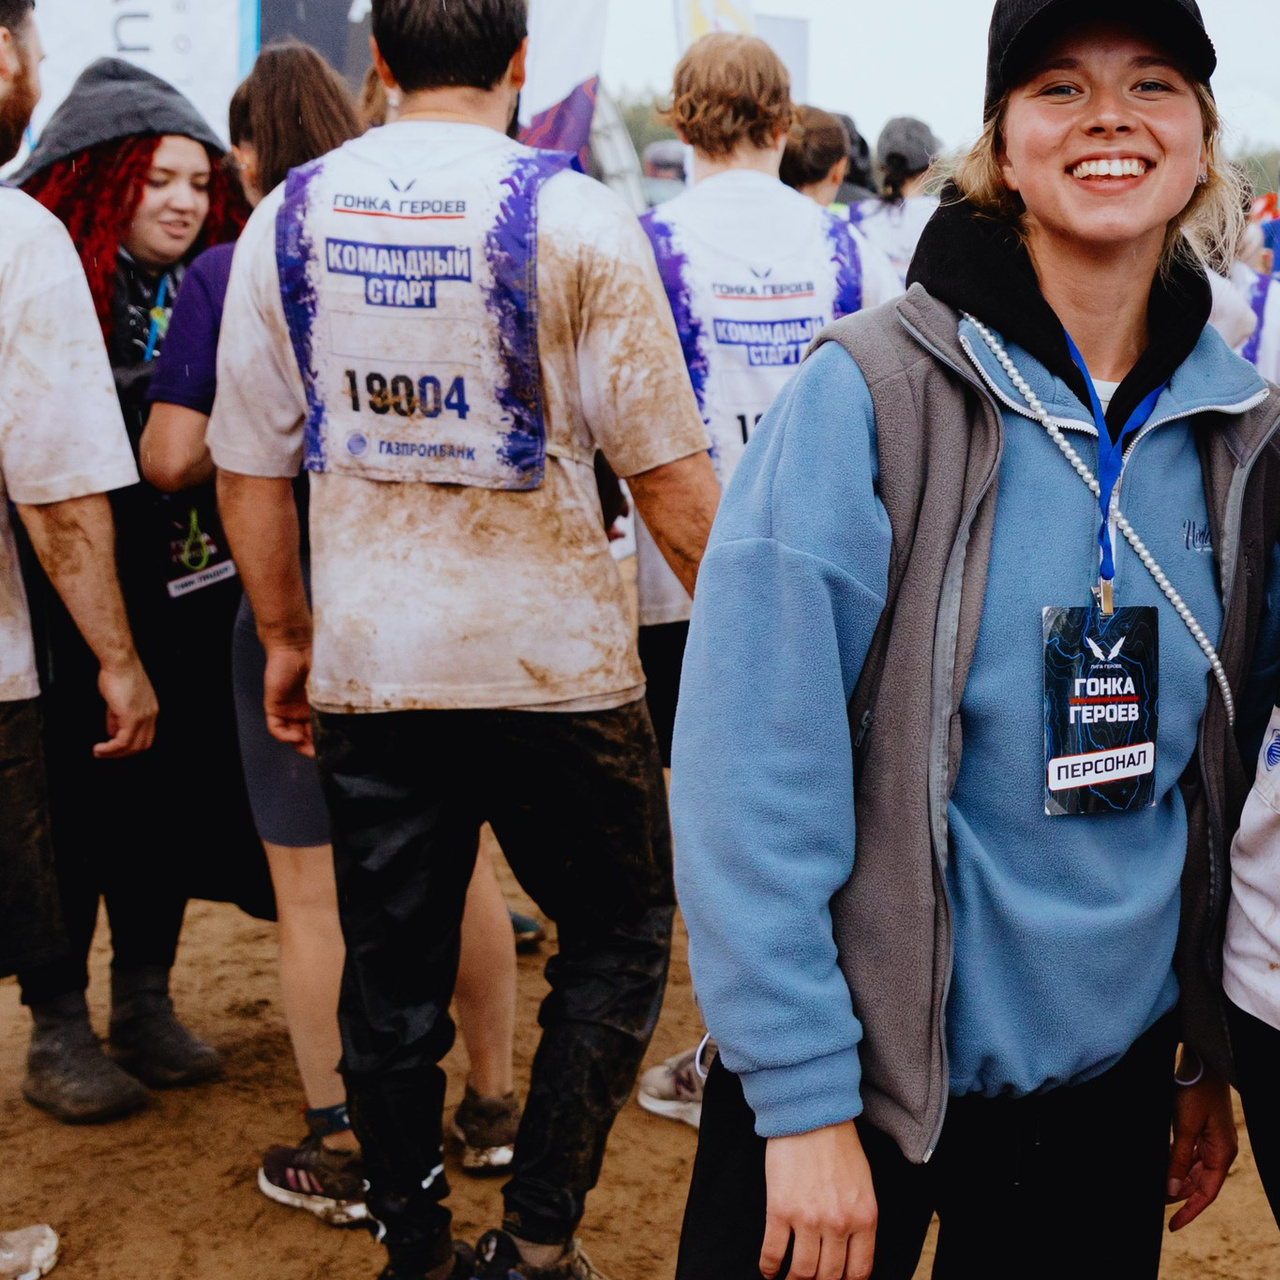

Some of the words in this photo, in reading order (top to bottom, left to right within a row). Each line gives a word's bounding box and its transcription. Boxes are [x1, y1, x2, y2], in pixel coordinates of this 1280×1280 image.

[333, 194, 391, 211] ГОНКА
[400, 200, 466, 213] ГЕРОЕВ
[327, 241, 470, 280] КОМАНДНЫЙ
[367, 278, 433, 306] СТАРТ
[712, 283, 758, 296] ГОНКА
[763, 281, 815, 295] ГЕРОЕВ
[751, 344, 799, 365] СТАРТ
[378, 440, 476, 461] ГАЗПРОМБАНК
[1074, 676, 1136, 696] ГОНКА
[1069, 703, 1140, 724] ГЕРОЕВ
[1057, 750, 1147, 781] ПЕРСОНАЛ
